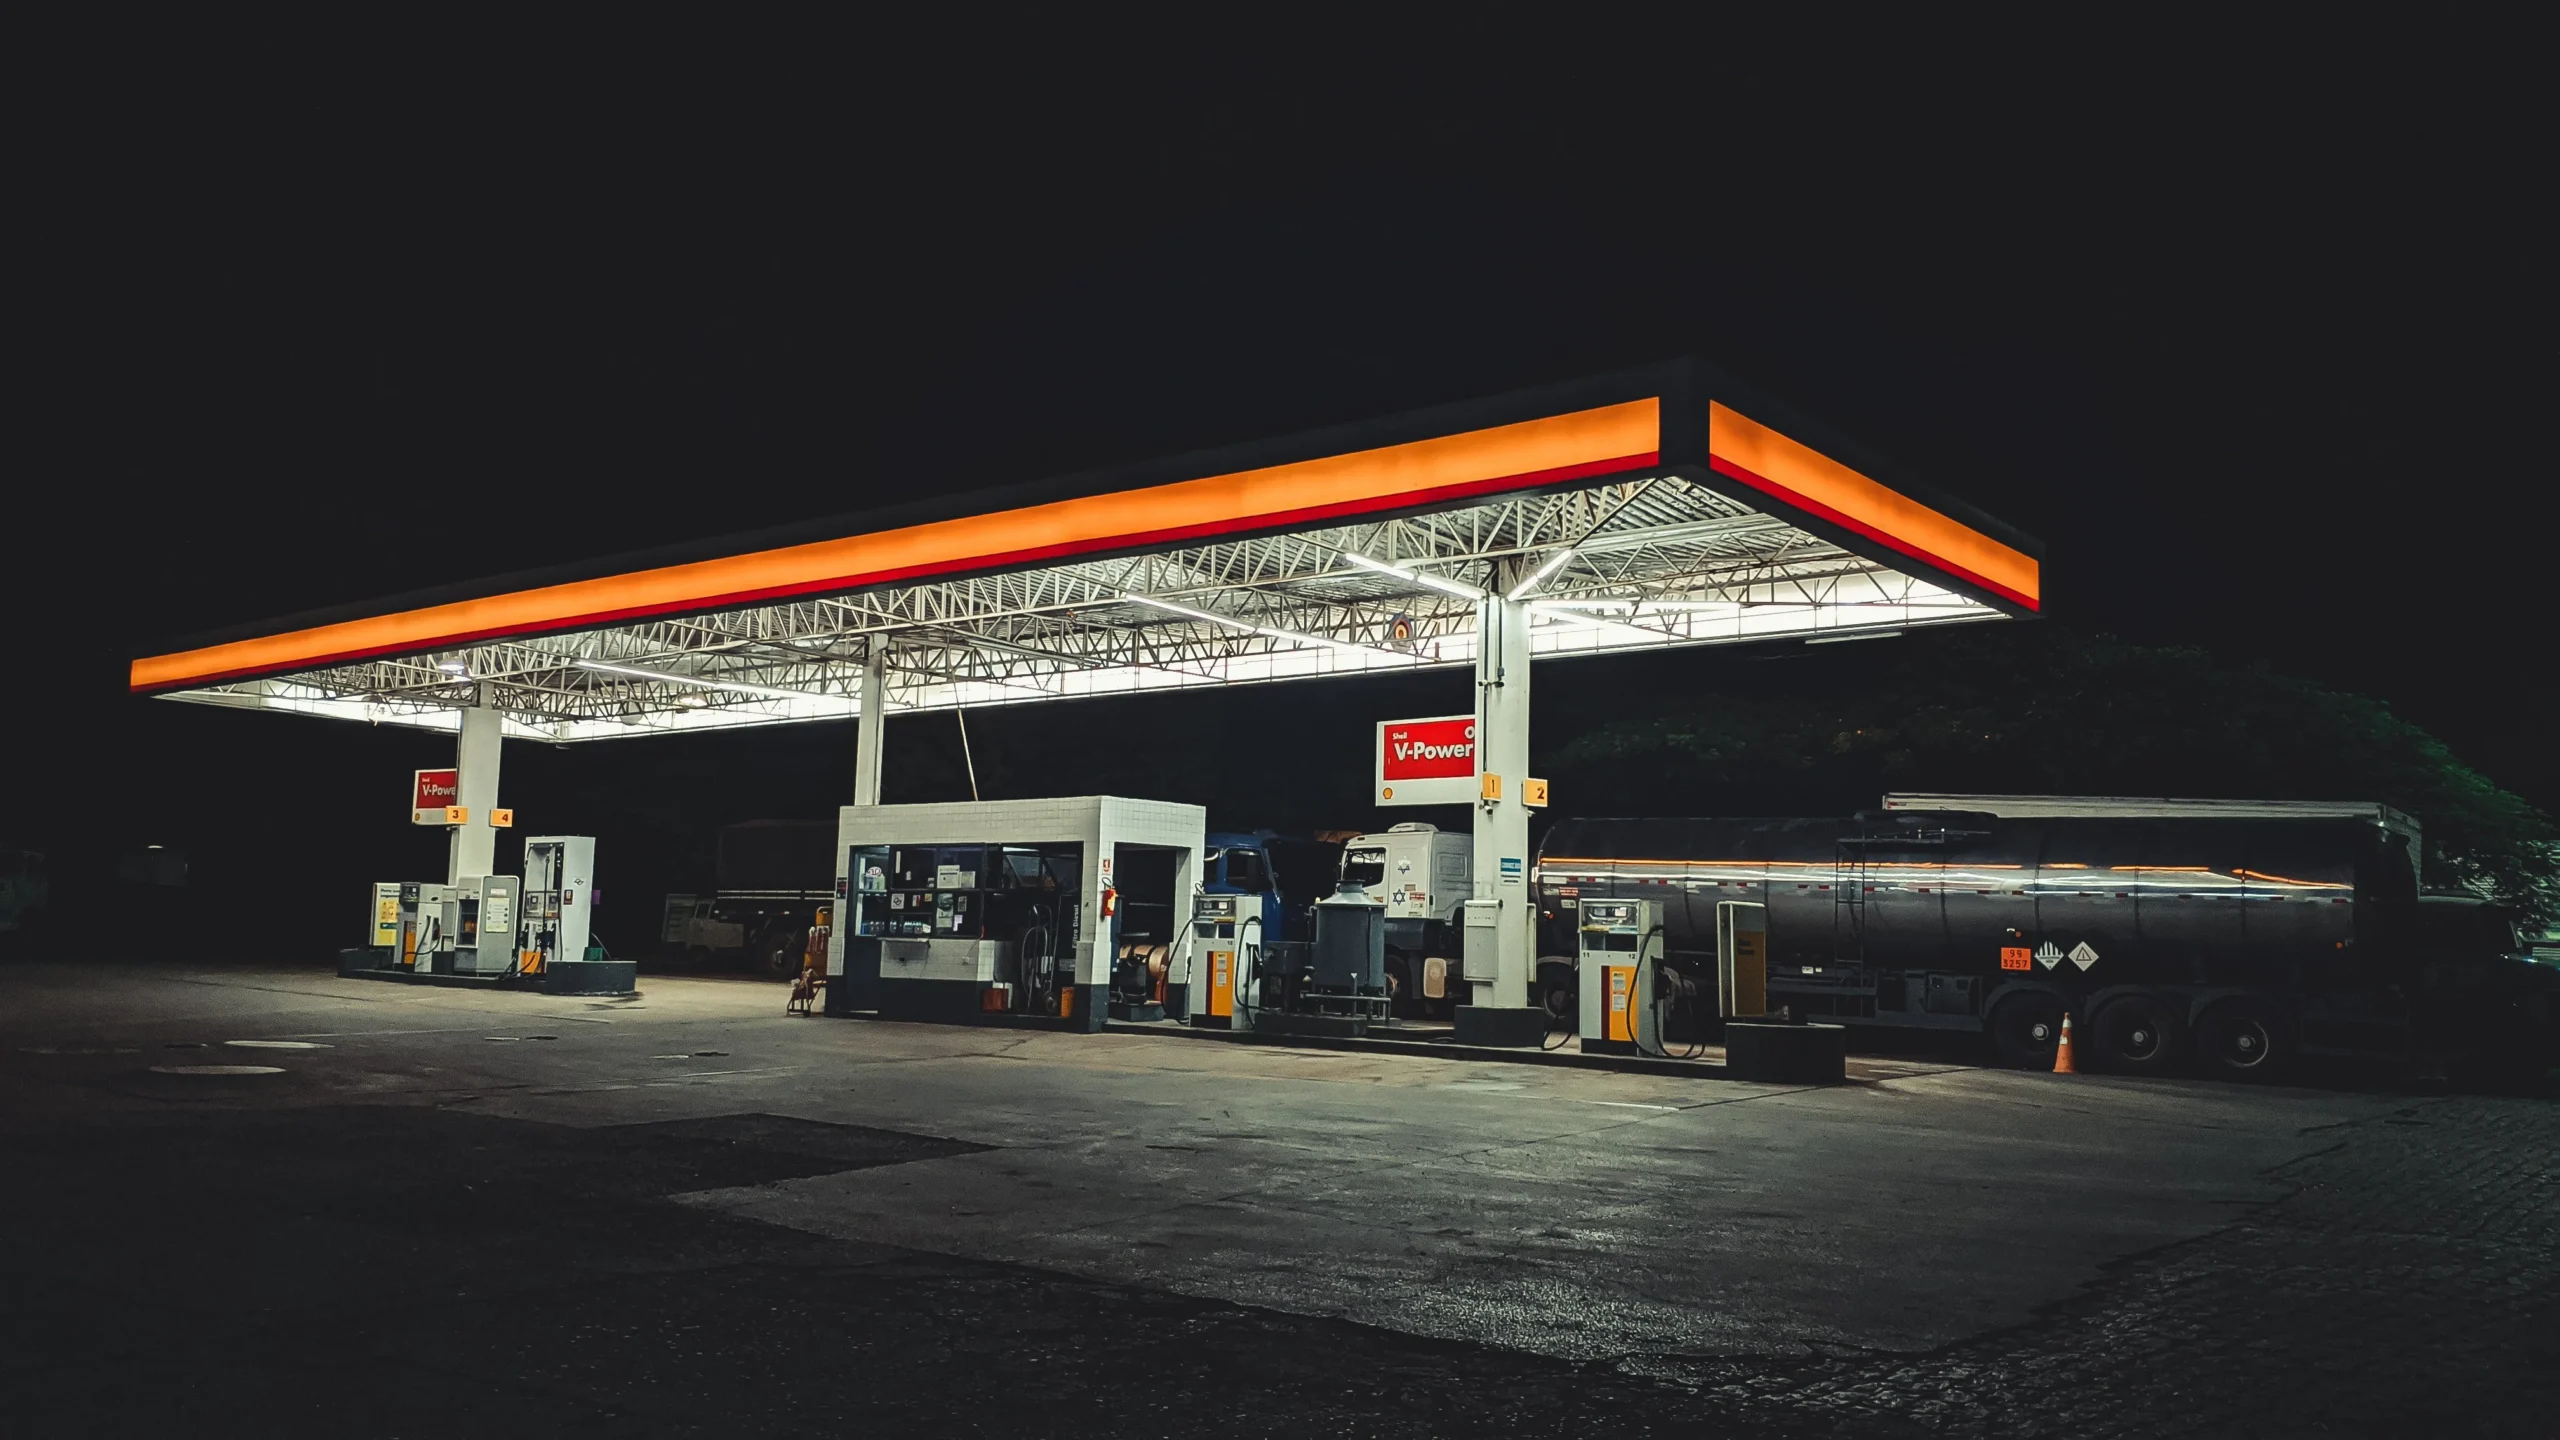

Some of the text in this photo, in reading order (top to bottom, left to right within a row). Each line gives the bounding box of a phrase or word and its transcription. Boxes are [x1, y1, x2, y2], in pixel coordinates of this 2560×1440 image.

[1392, 732, 1407, 740] Shell
[1394, 742, 1474, 761] V-Power
[1491, 779, 1495, 793] 1
[1537, 787, 1545, 800] 2
[452, 810, 459, 819] 3
[502, 814, 509, 823] 4
[2009, 949, 2022, 958] 99
[2003, 959, 2028, 968] 3257
